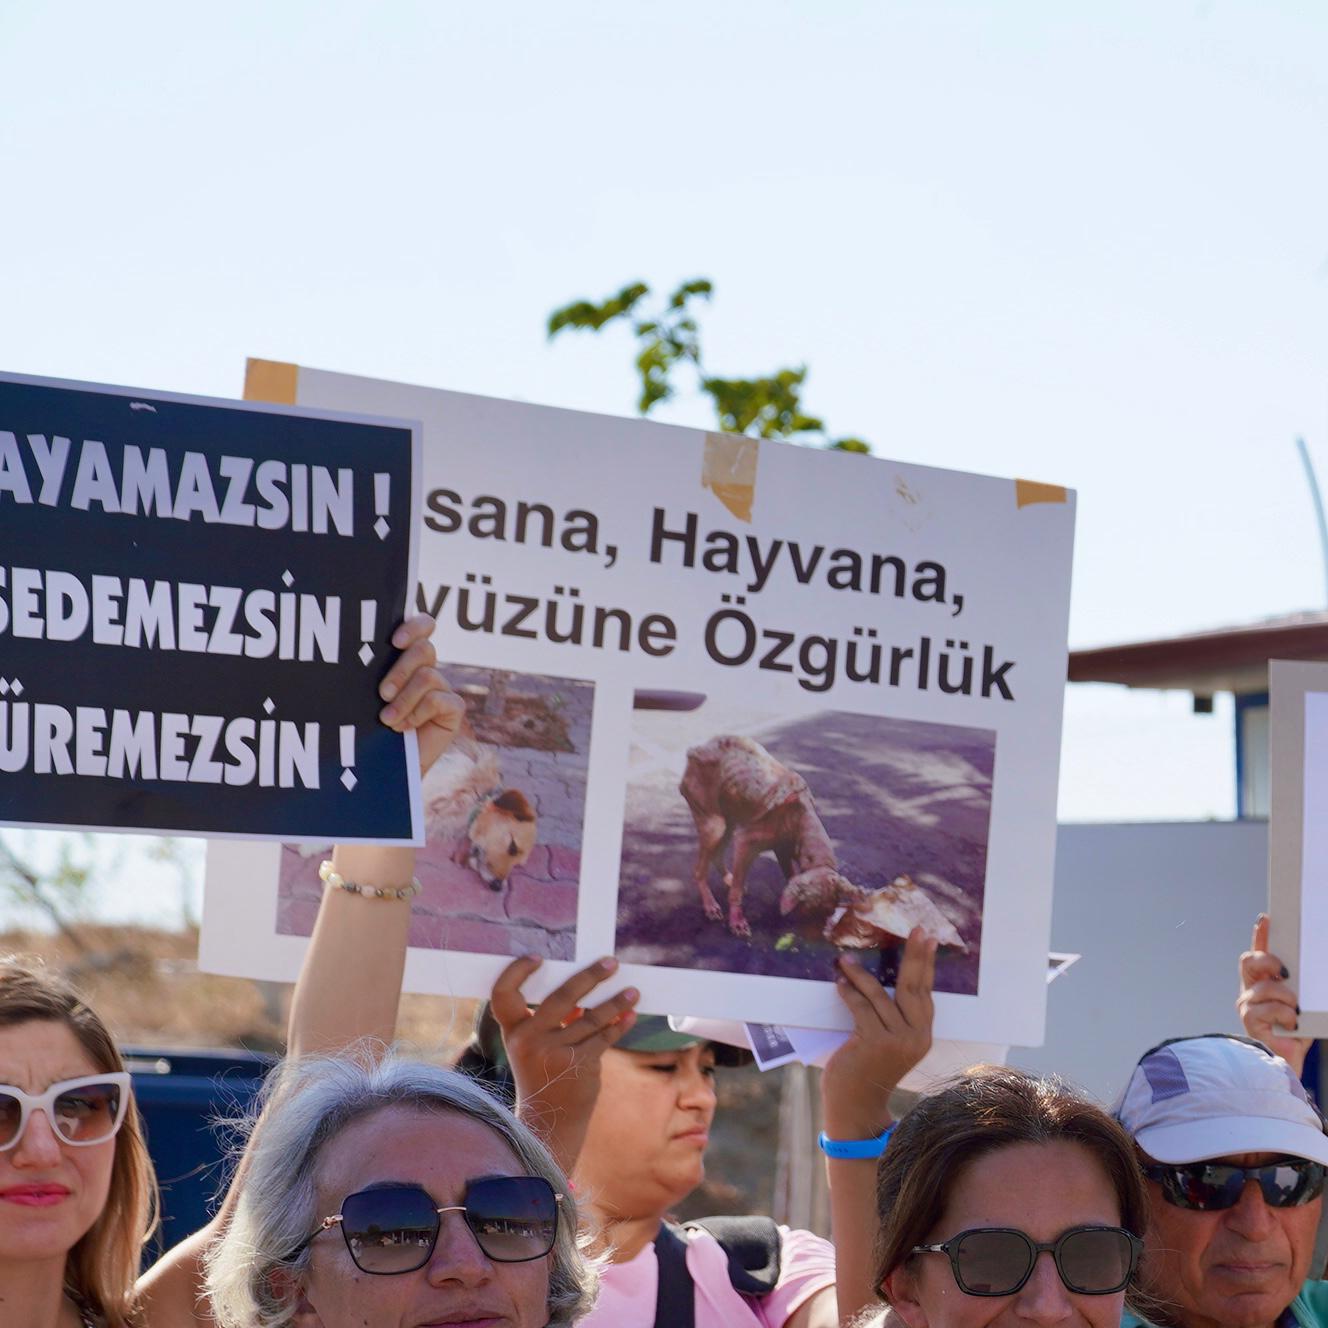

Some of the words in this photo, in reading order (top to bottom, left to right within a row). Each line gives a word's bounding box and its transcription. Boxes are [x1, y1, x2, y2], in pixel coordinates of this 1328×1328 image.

[0, 430, 356, 537] AYAMAZSIN
[648, 507, 965, 616] Hayvana,
[704, 594, 1016, 701] Özgürlük
